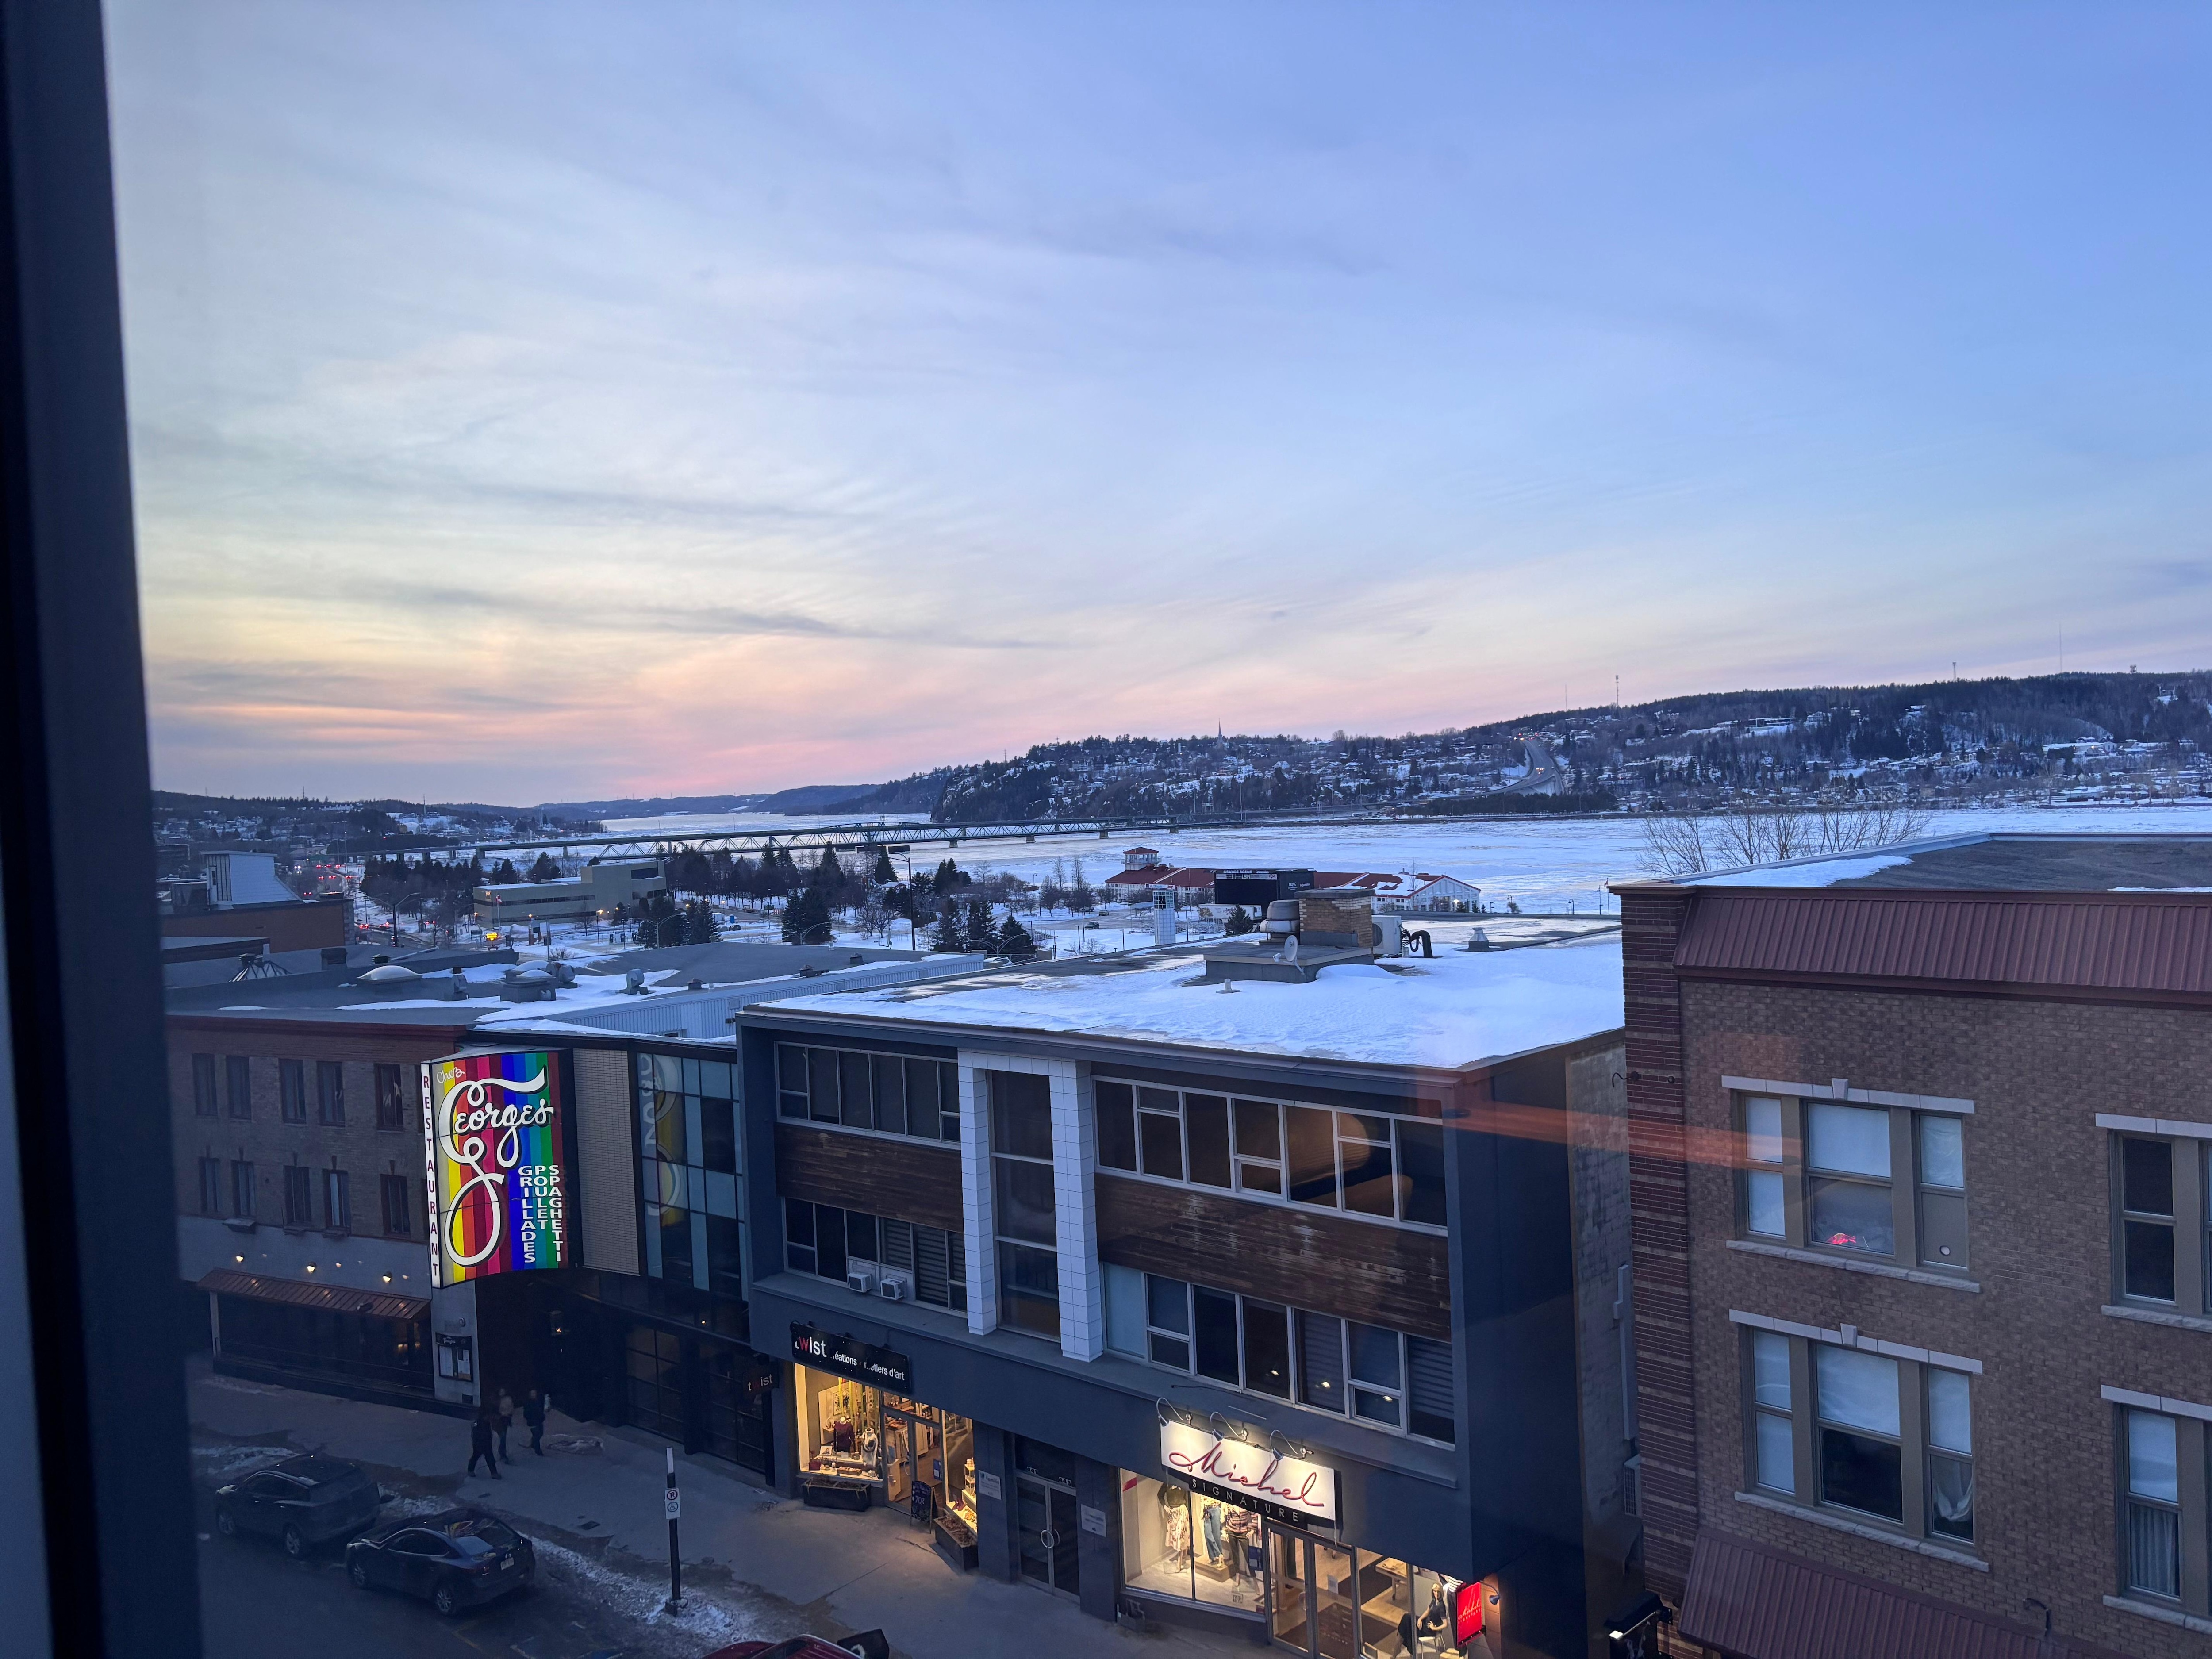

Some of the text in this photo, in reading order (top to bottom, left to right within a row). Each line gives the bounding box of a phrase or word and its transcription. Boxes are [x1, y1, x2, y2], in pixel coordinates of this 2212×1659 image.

[437, 1067, 465, 1083] Chez
[423, 1075, 438, 1278] RESTAURANT
[438, 1066, 554, 1266] Georges
[534, 1165, 549, 1229] POULET
[518, 1165, 536, 1263] GRILLADES
[549, 1165, 564, 1262] SPAGHETTI
[748, 1374, 773, 1391] tist
[830, 1351, 905, 1381] éations tiers d'art
[1168, 1441, 1325, 1507] Michel
[1192, 1479, 1298, 1522] SIGNATURE
